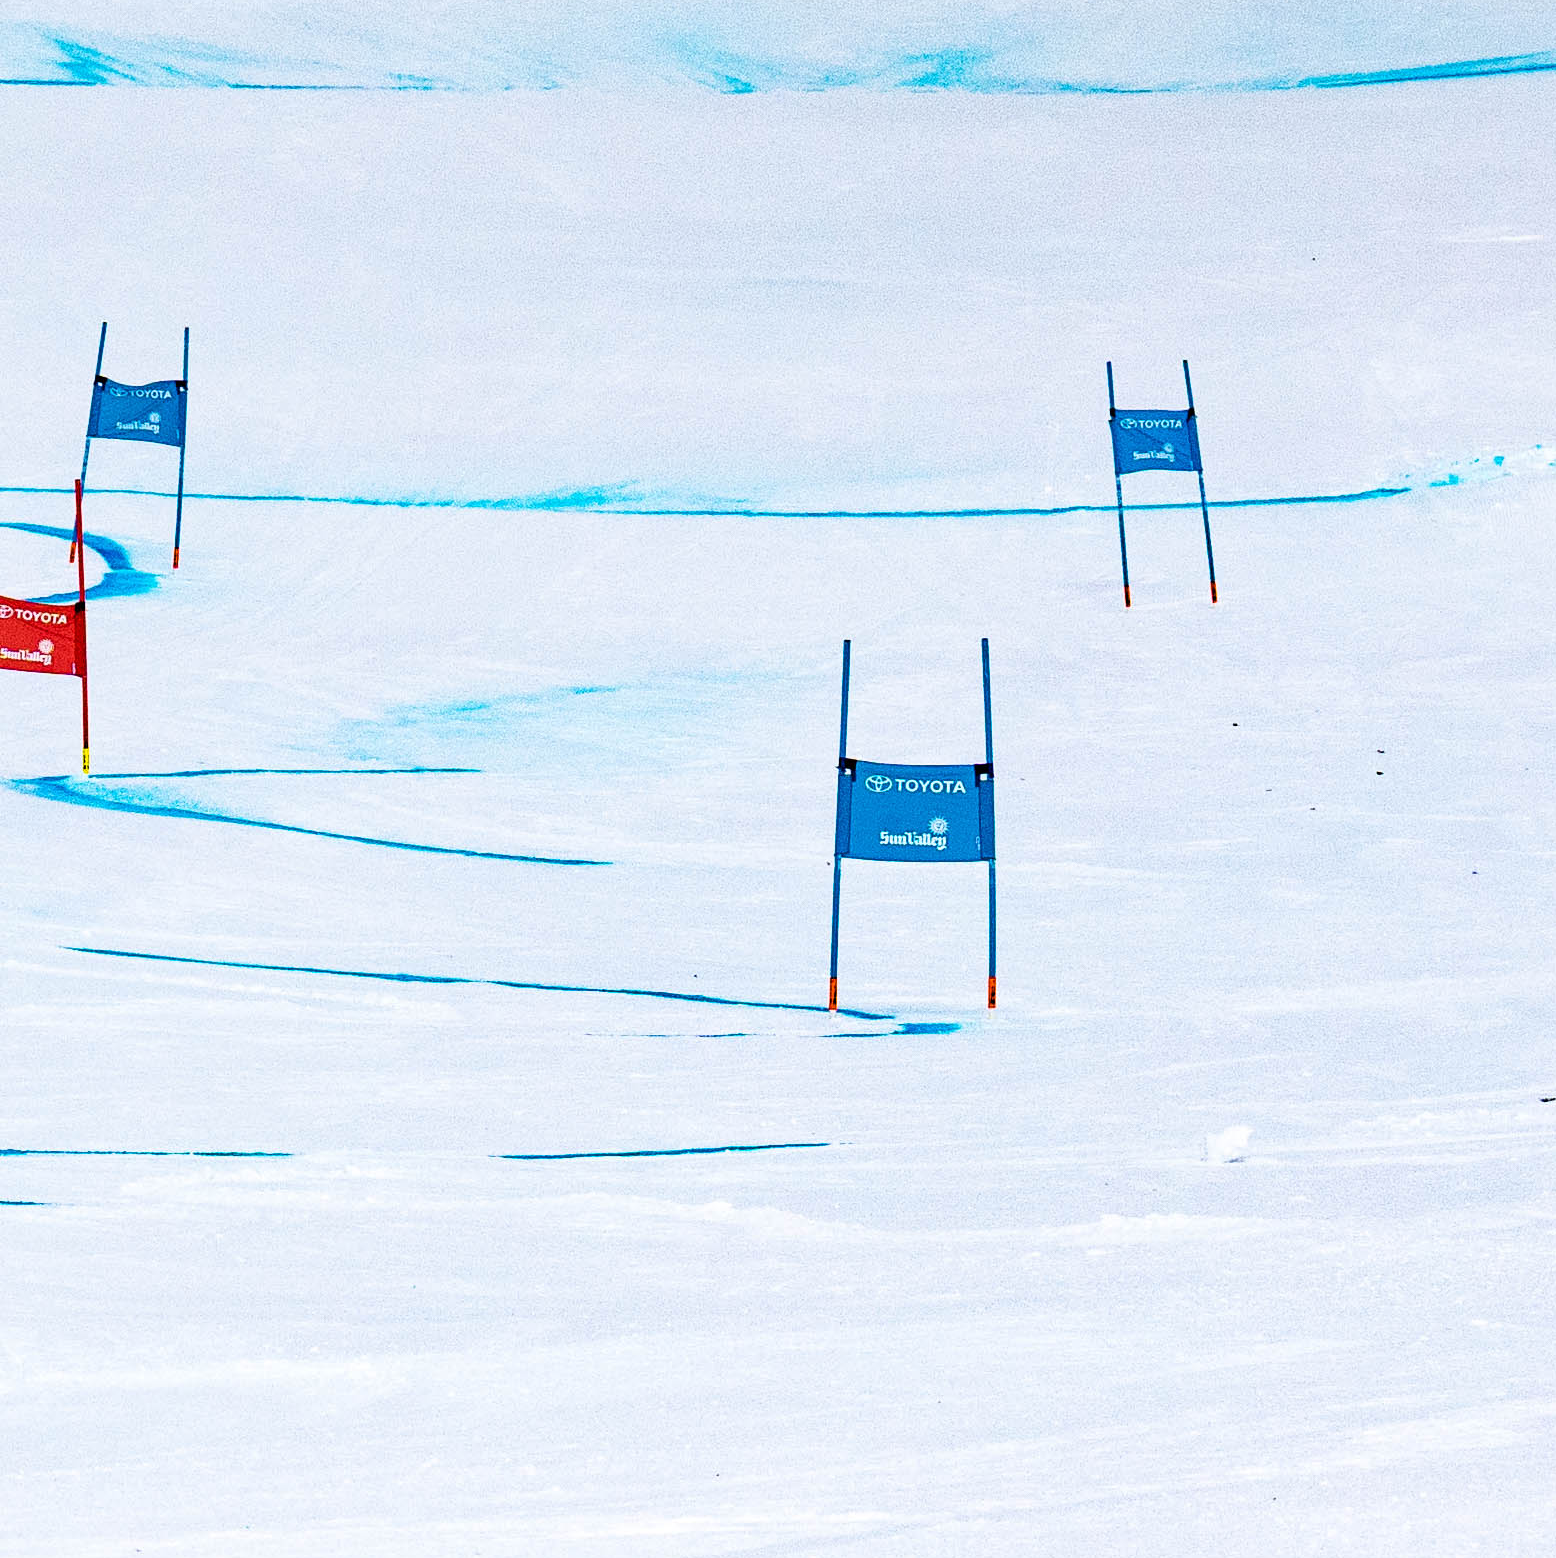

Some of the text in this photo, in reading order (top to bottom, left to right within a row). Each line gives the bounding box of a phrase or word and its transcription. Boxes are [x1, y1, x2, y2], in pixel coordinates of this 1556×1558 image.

[1138, 419, 1183, 429] TOYOTA
[14, 608, 68, 625] TOYOTA
[895, 778, 966, 794] TOYOTA
